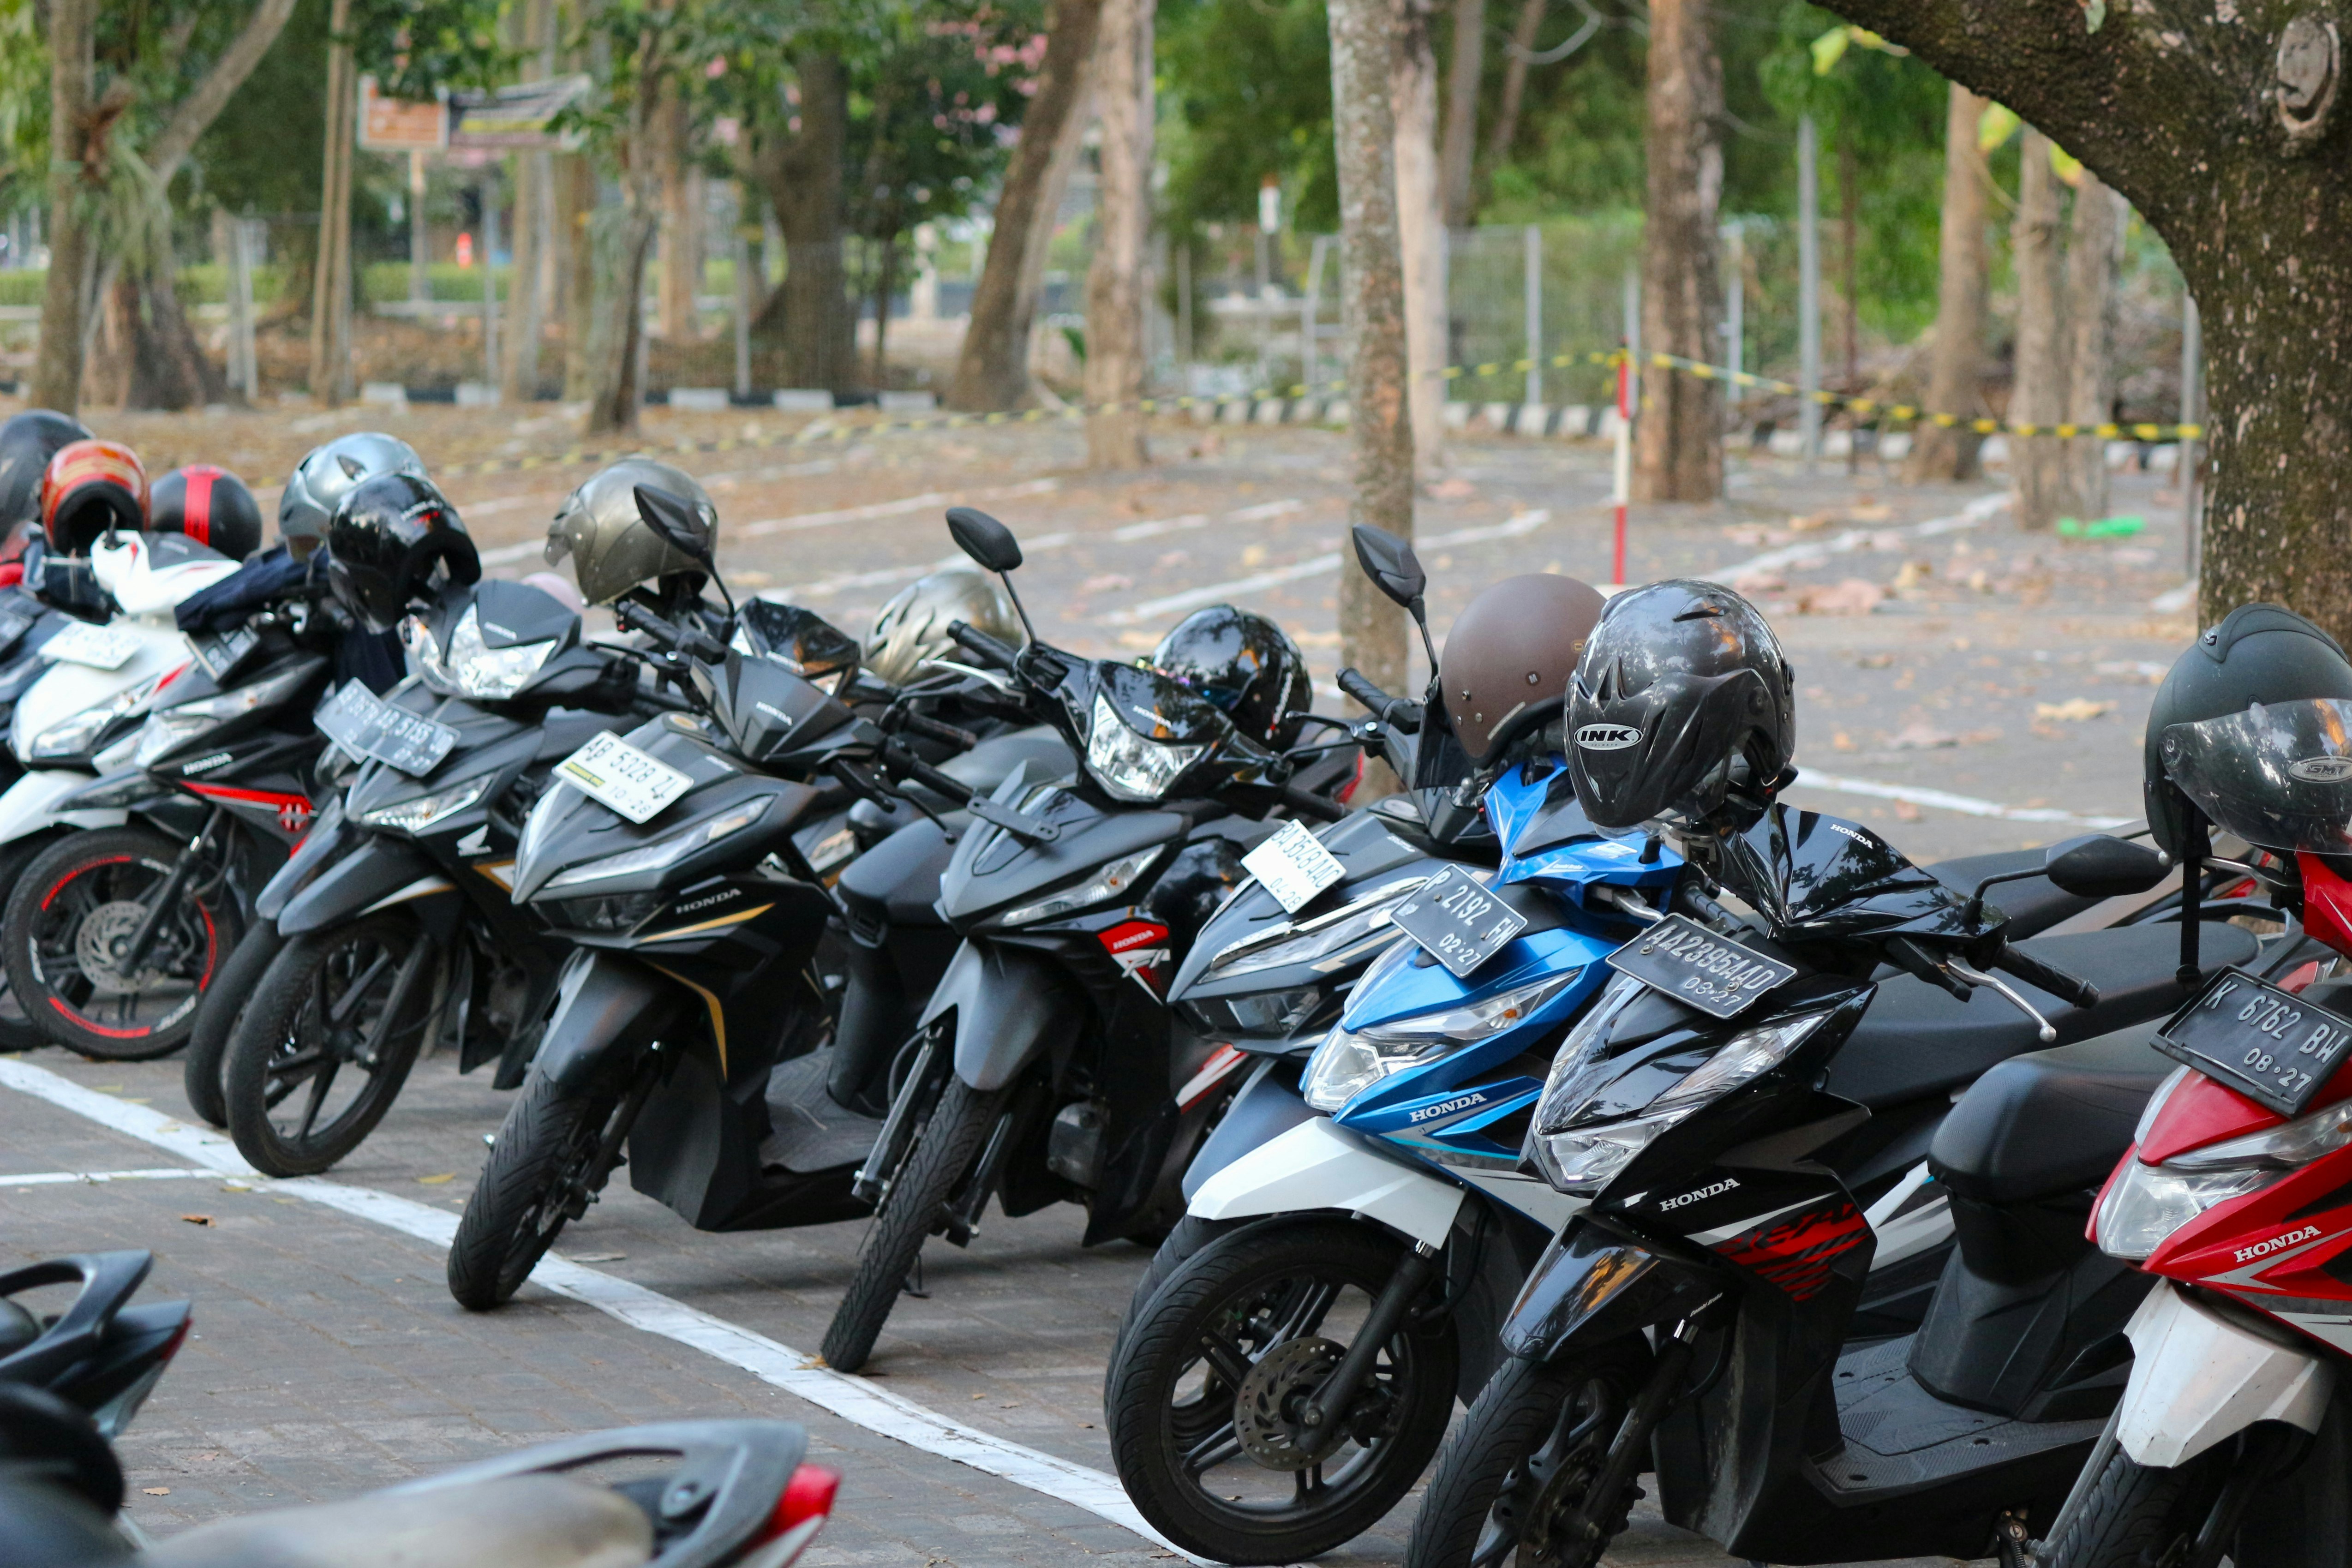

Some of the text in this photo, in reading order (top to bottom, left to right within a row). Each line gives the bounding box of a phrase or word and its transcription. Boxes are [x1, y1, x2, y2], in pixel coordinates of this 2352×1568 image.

[1580, 730, 1634, 742] INK
[183, 752, 233, 776] HONDA
[585, 737, 614, 761] AB
[610, 752, 655, 783] 5328
[2305, 764, 2349, 775] GMT
[1830, 824, 1873, 849] HONDA
[676, 888, 742, 915] HONDA
[1442, 885, 1492, 926] 2192
[1113, 929, 1155, 950] HONDA
[2205, 981, 2350, 1064] K 6762 BW
[1409, 1093, 1487, 1122] HONDA
[1659, 1178, 1741, 1212] HONDA
[2234, 1225, 2322, 1263] HONDA
